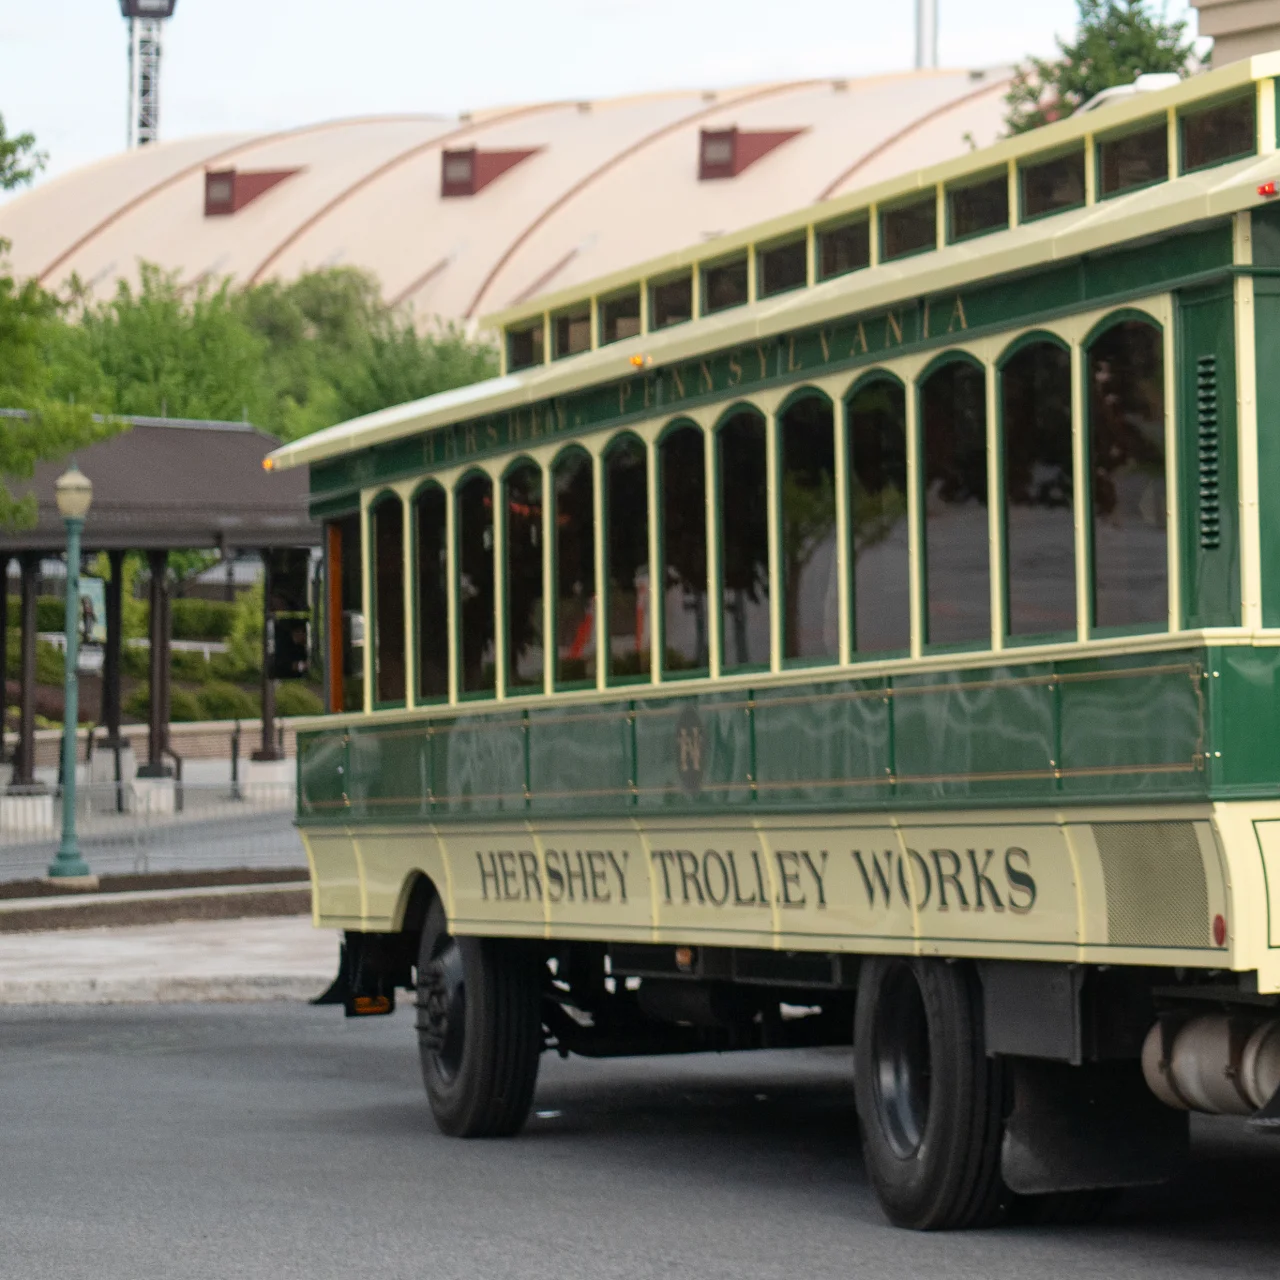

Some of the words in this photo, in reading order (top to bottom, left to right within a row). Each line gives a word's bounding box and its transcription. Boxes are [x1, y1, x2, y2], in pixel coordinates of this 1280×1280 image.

[476, 849, 630, 904] HERSHEY
[652, 850, 829, 911] TROLLEY
[852, 846, 1038, 915] WORKS
